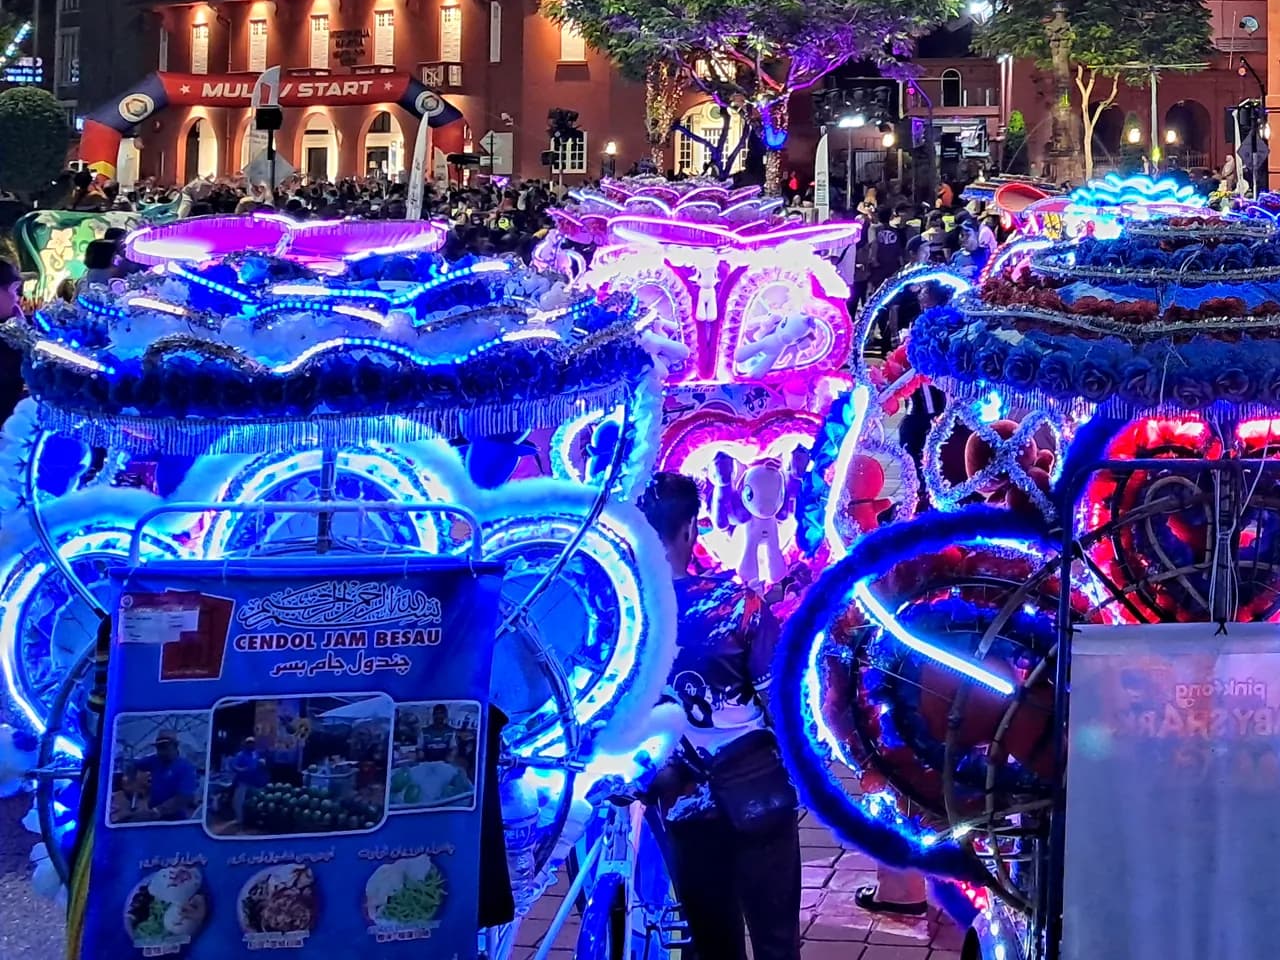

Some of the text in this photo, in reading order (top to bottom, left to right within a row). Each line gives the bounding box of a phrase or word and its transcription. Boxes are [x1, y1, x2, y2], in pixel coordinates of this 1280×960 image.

[202, 82, 254, 98] MUL
[297, 81, 374, 98] START
[234, 627, 442, 652] CENDOL JAM BESAU
